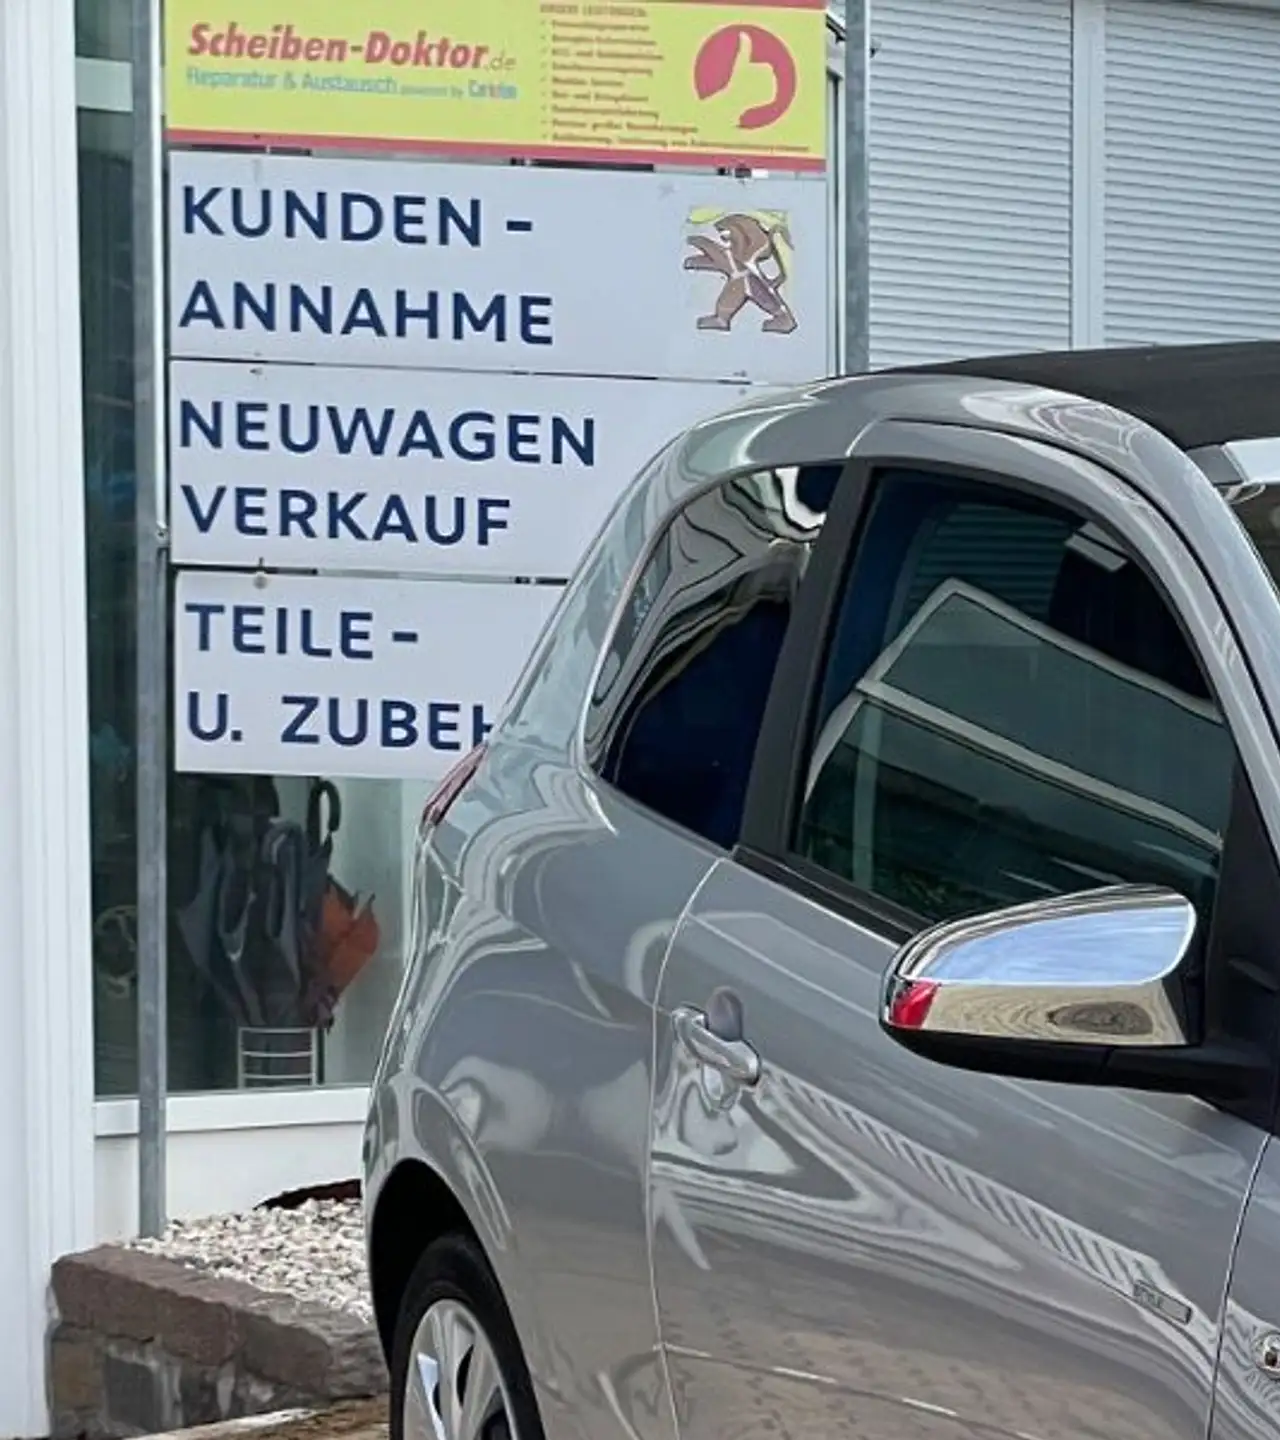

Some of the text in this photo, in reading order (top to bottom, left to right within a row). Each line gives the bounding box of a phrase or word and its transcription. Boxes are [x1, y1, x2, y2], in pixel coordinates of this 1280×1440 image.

[179, 281, 552, 344] ANNAHME
[181, 400, 594, 466] NEUWAGEN
[181, 485, 510, 545] VERKAUF
[189, 692, 242, 741] U.
